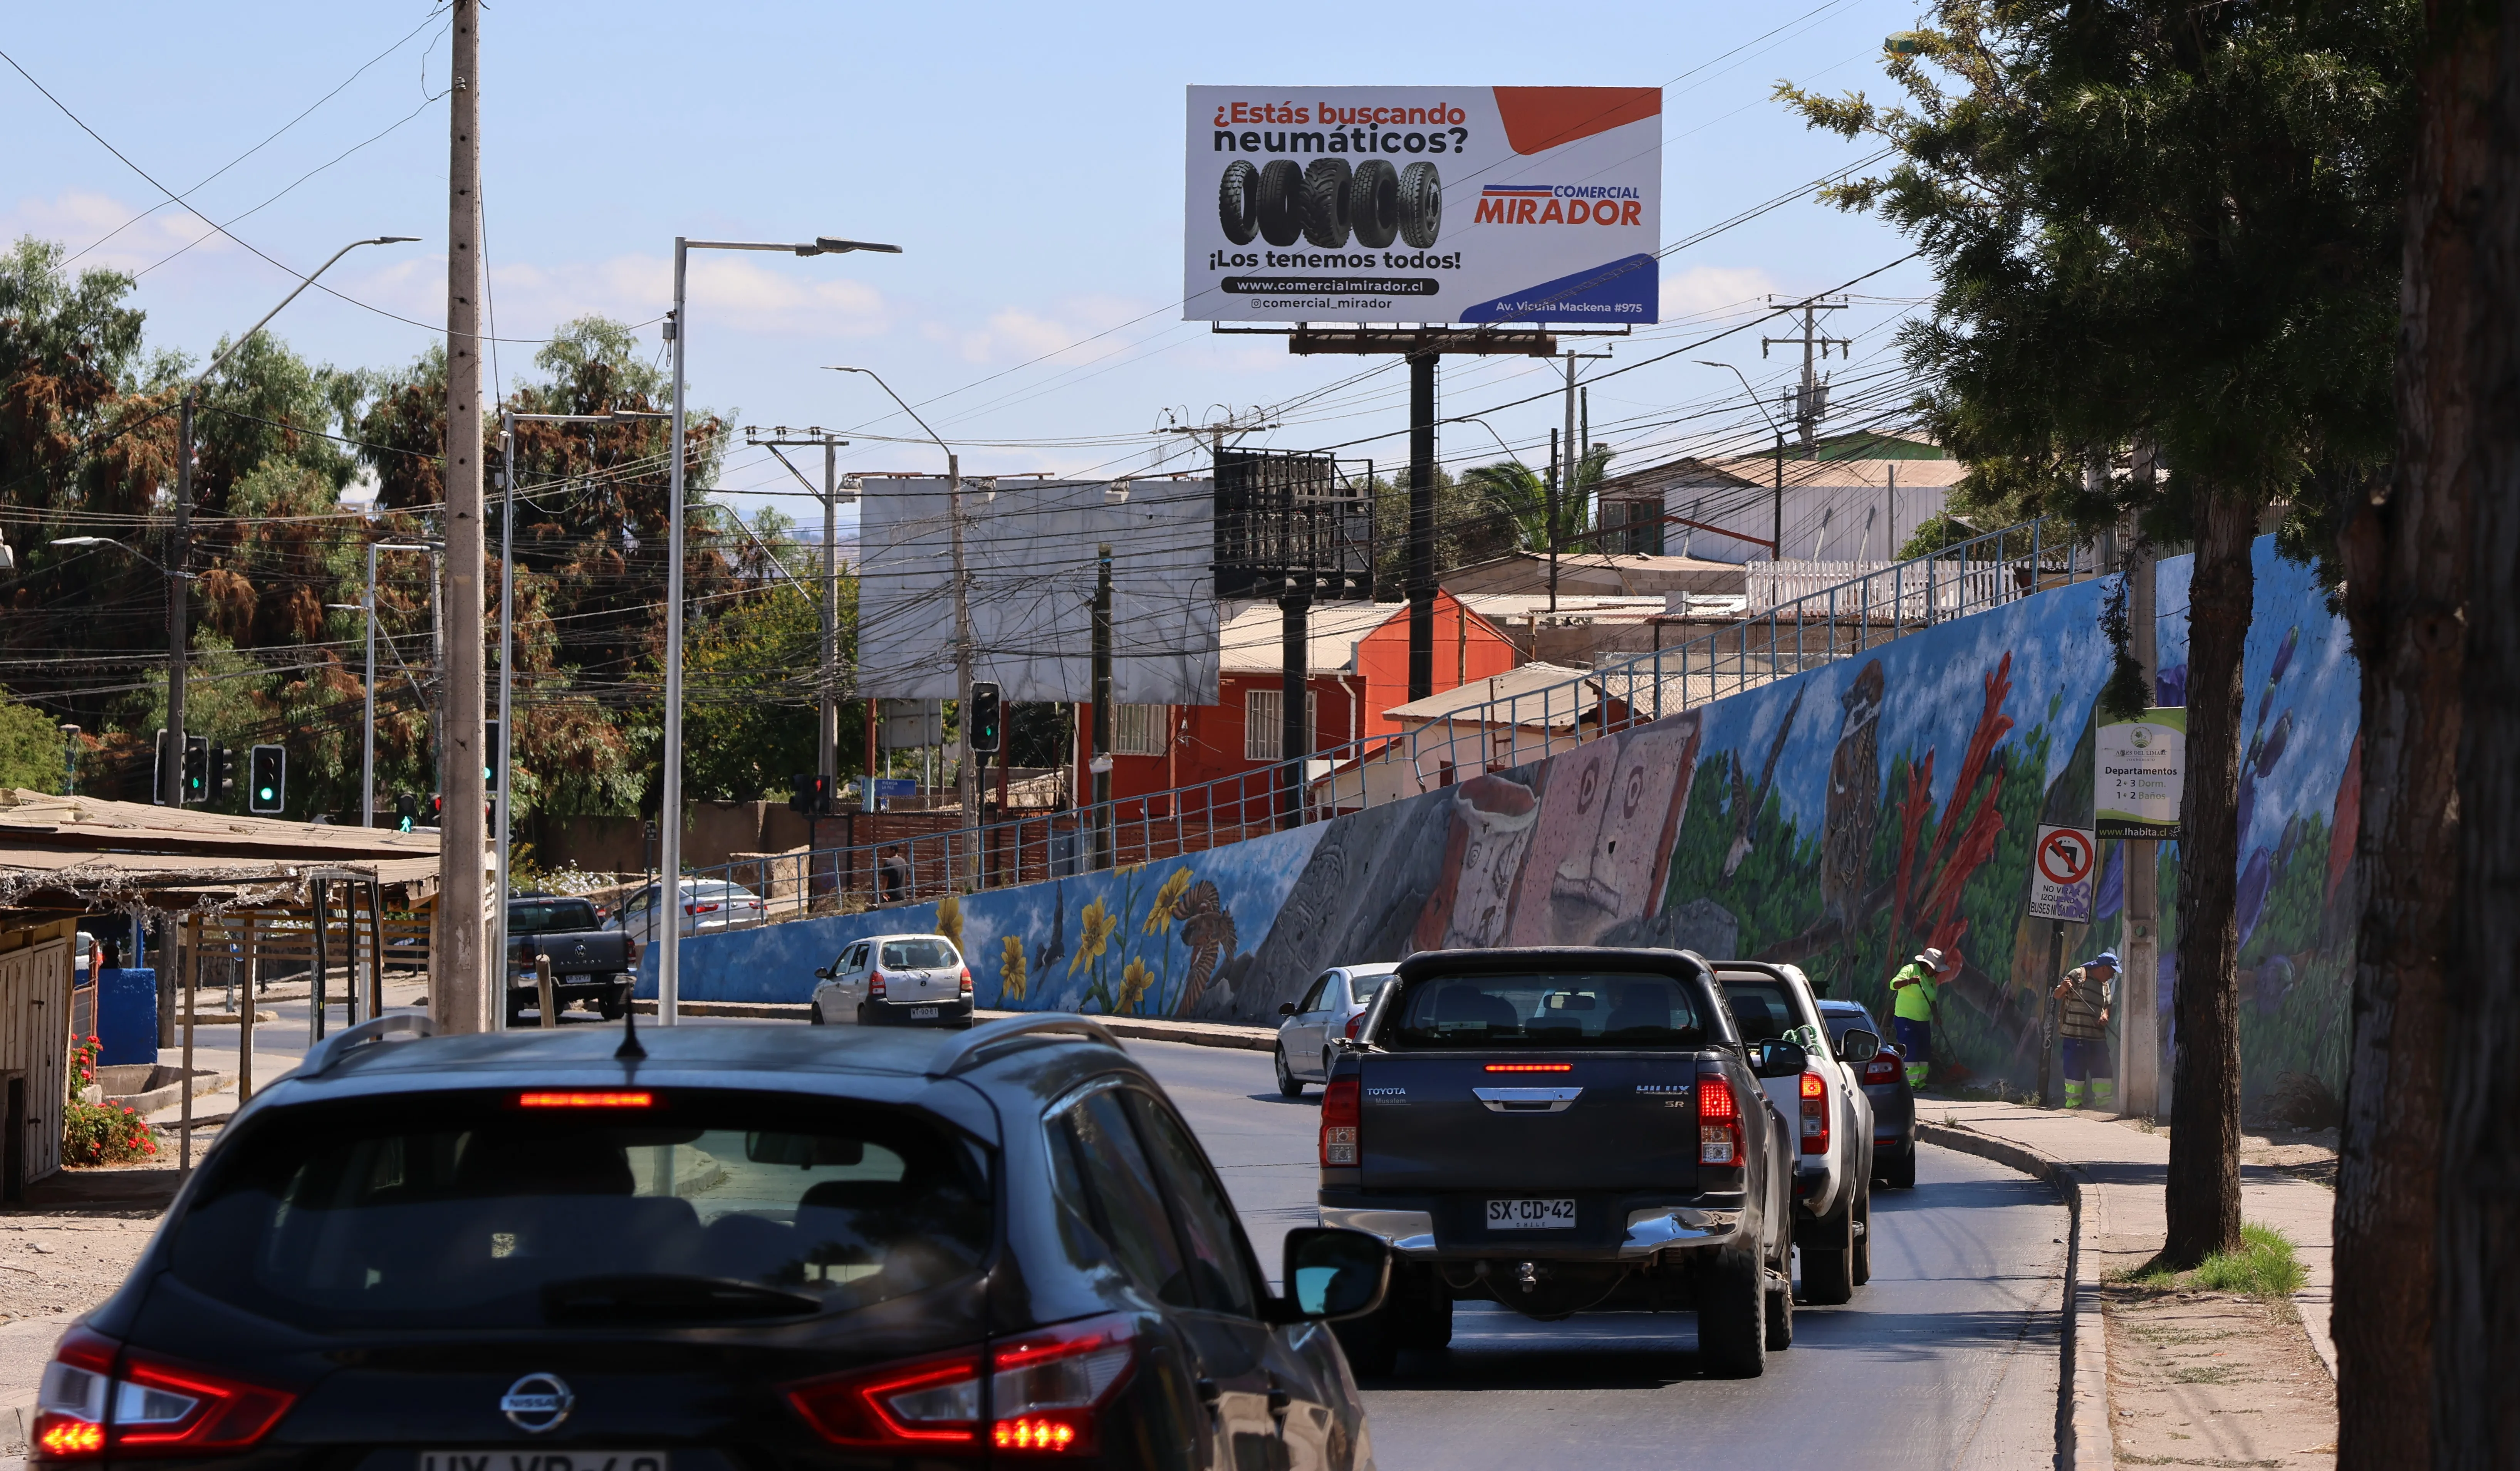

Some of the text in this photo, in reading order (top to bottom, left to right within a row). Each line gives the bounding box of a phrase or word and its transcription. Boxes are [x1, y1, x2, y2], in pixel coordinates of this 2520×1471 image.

[1213, 101, 1466, 128] ¿Estás buscando
[1214, 123, 1468, 154] neumáticos?
[1554, 185, 1640, 199] COMERCIAL
[1474, 199, 1641, 226] MIRADOR
[1210, 250, 1461, 270] ¡Los tenemos todos!
[1237, 280, 1423, 292] www.comercialmirador.cl
[1263, 298, 1392, 309] comercial_mirador
[1496, 301, 1643, 312] Av. Vicuña Mackena #975
[2105, 766, 2177, 776] Departamentos
[2138, 779, 2166, 788] Dorm.
[2138, 791, 2166, 800] Baños
[2030, 902, 2050, 915] BUSES
[2050, 904, 2057, 916] NI
[1636, 1085, 1690, 1095] HILUX
[509, 1398, 564, 1407] NISSA
